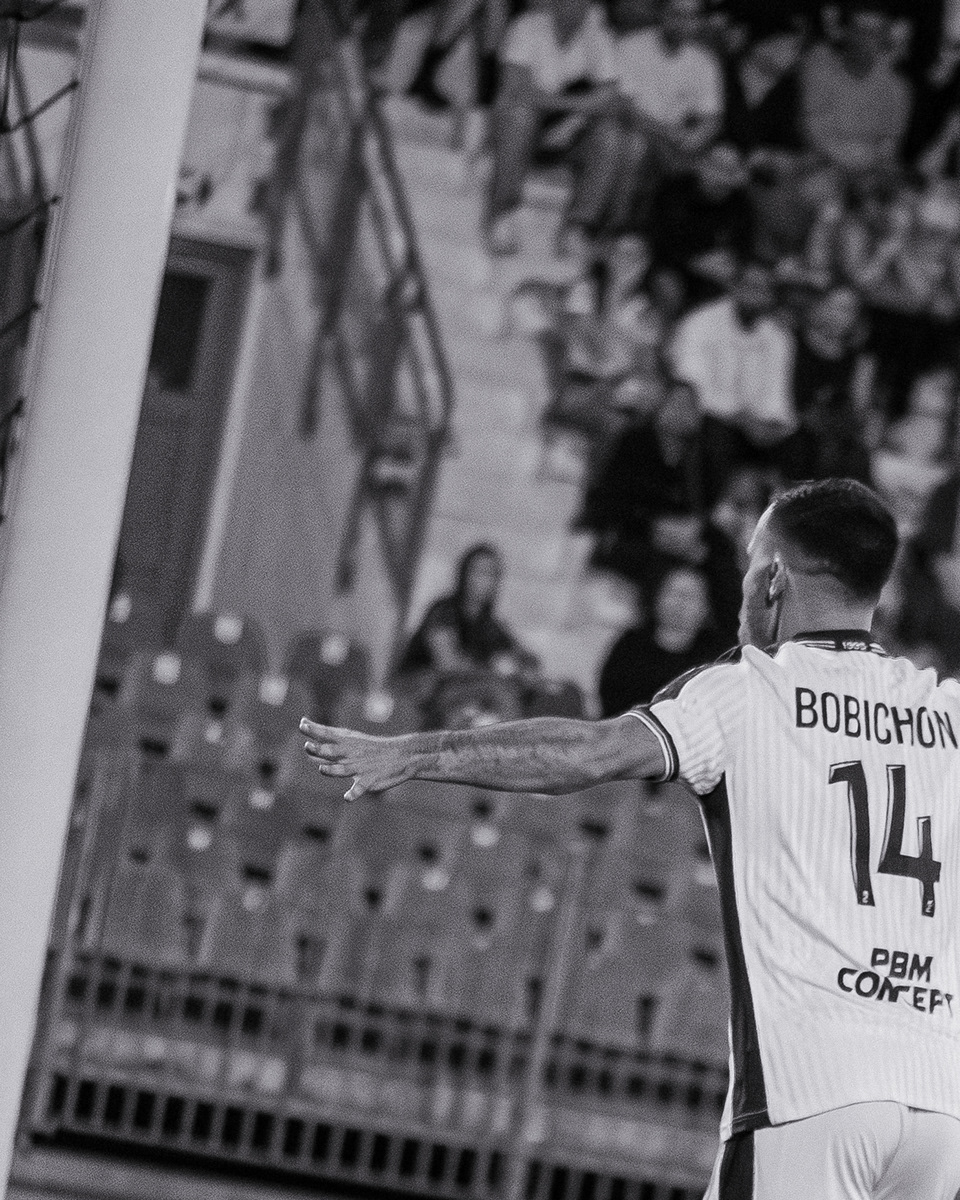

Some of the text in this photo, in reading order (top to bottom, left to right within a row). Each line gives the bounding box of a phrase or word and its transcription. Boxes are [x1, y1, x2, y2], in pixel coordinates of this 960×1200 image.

[794, 686, 959, 750] BOBICHON
[828, 760, 942, 918] 14
[870, 947, 934, 983] PBM
